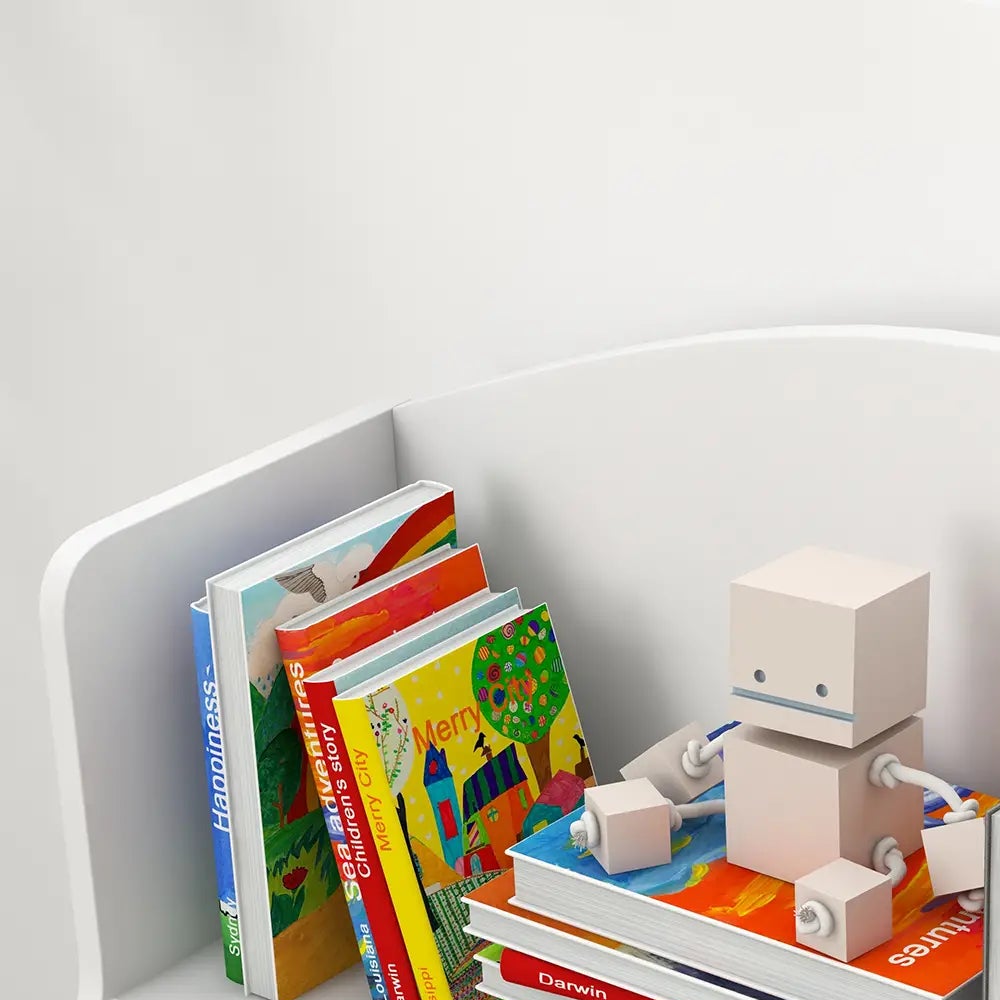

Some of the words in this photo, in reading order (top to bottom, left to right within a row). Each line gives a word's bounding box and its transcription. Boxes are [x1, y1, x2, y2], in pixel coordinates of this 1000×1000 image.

[411, 702, 481, 755] Merry
[488, 669, 533, 713] City
[320, 723, 343, 772] story
[353, 748, 372, 788] City
[336, 778, 371, 878] Children's
[367, 794, 392, 851] Merry
[337, 843, 363, 901] Sea
[888, 910, 981, 967] ntures
[538, 972, 607, 1000] Darwin
